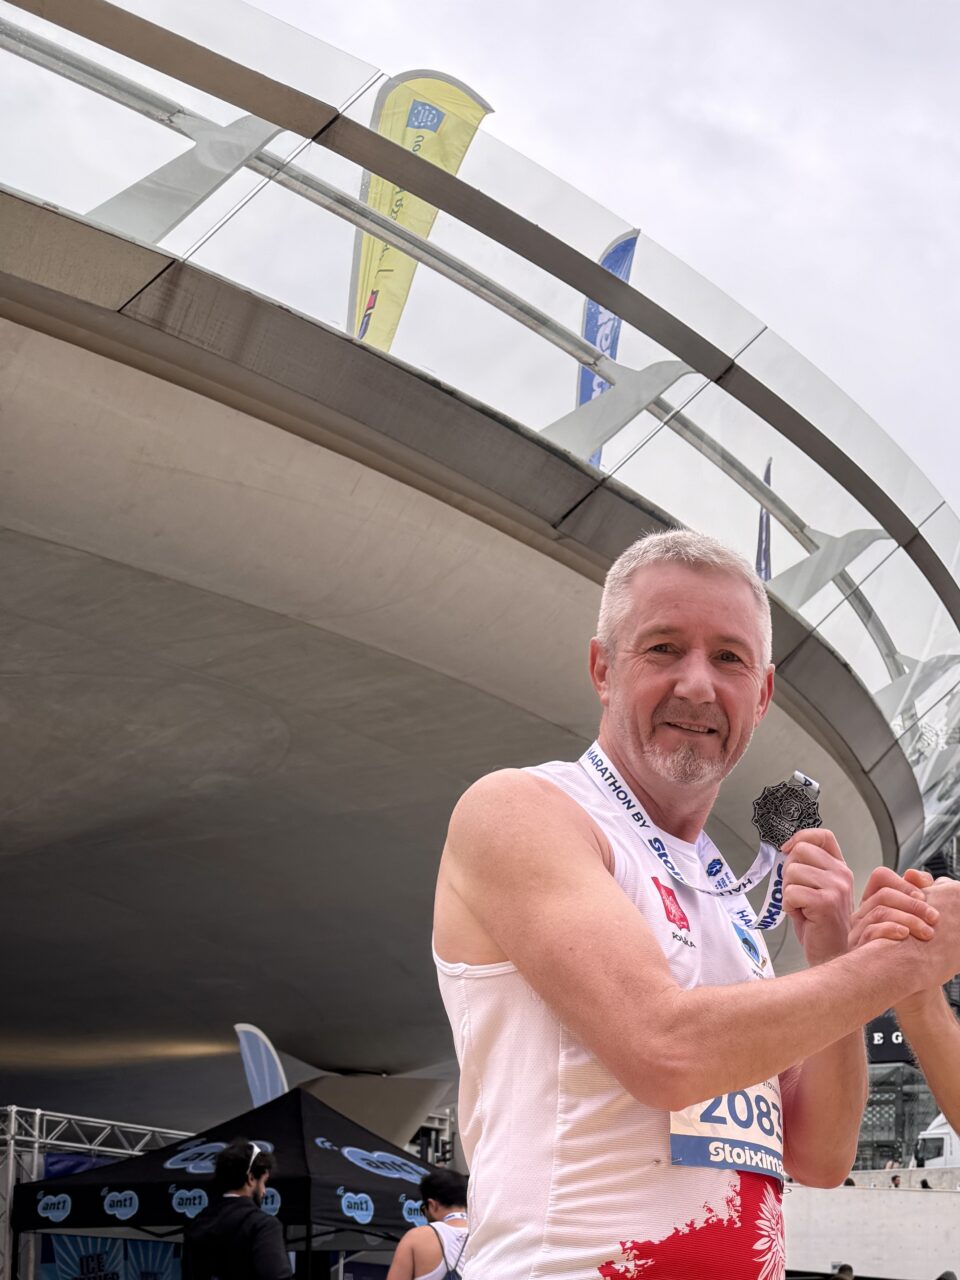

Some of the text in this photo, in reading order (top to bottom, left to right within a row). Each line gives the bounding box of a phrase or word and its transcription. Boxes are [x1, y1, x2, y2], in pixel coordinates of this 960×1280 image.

[586, 748, 636, 811] MARATHON
[632, 811, 651, 829] BY
[708, 1141, 784, 1174] Stoixima
[42, 1200, 67, 1212] ant1
[108, 1197, 133, 1209] ant1
[177, 1194, 203, 1207] ant1
[346, 1200, 369, 1212] ant1
[79, 1254, 106, 1276] ICE
